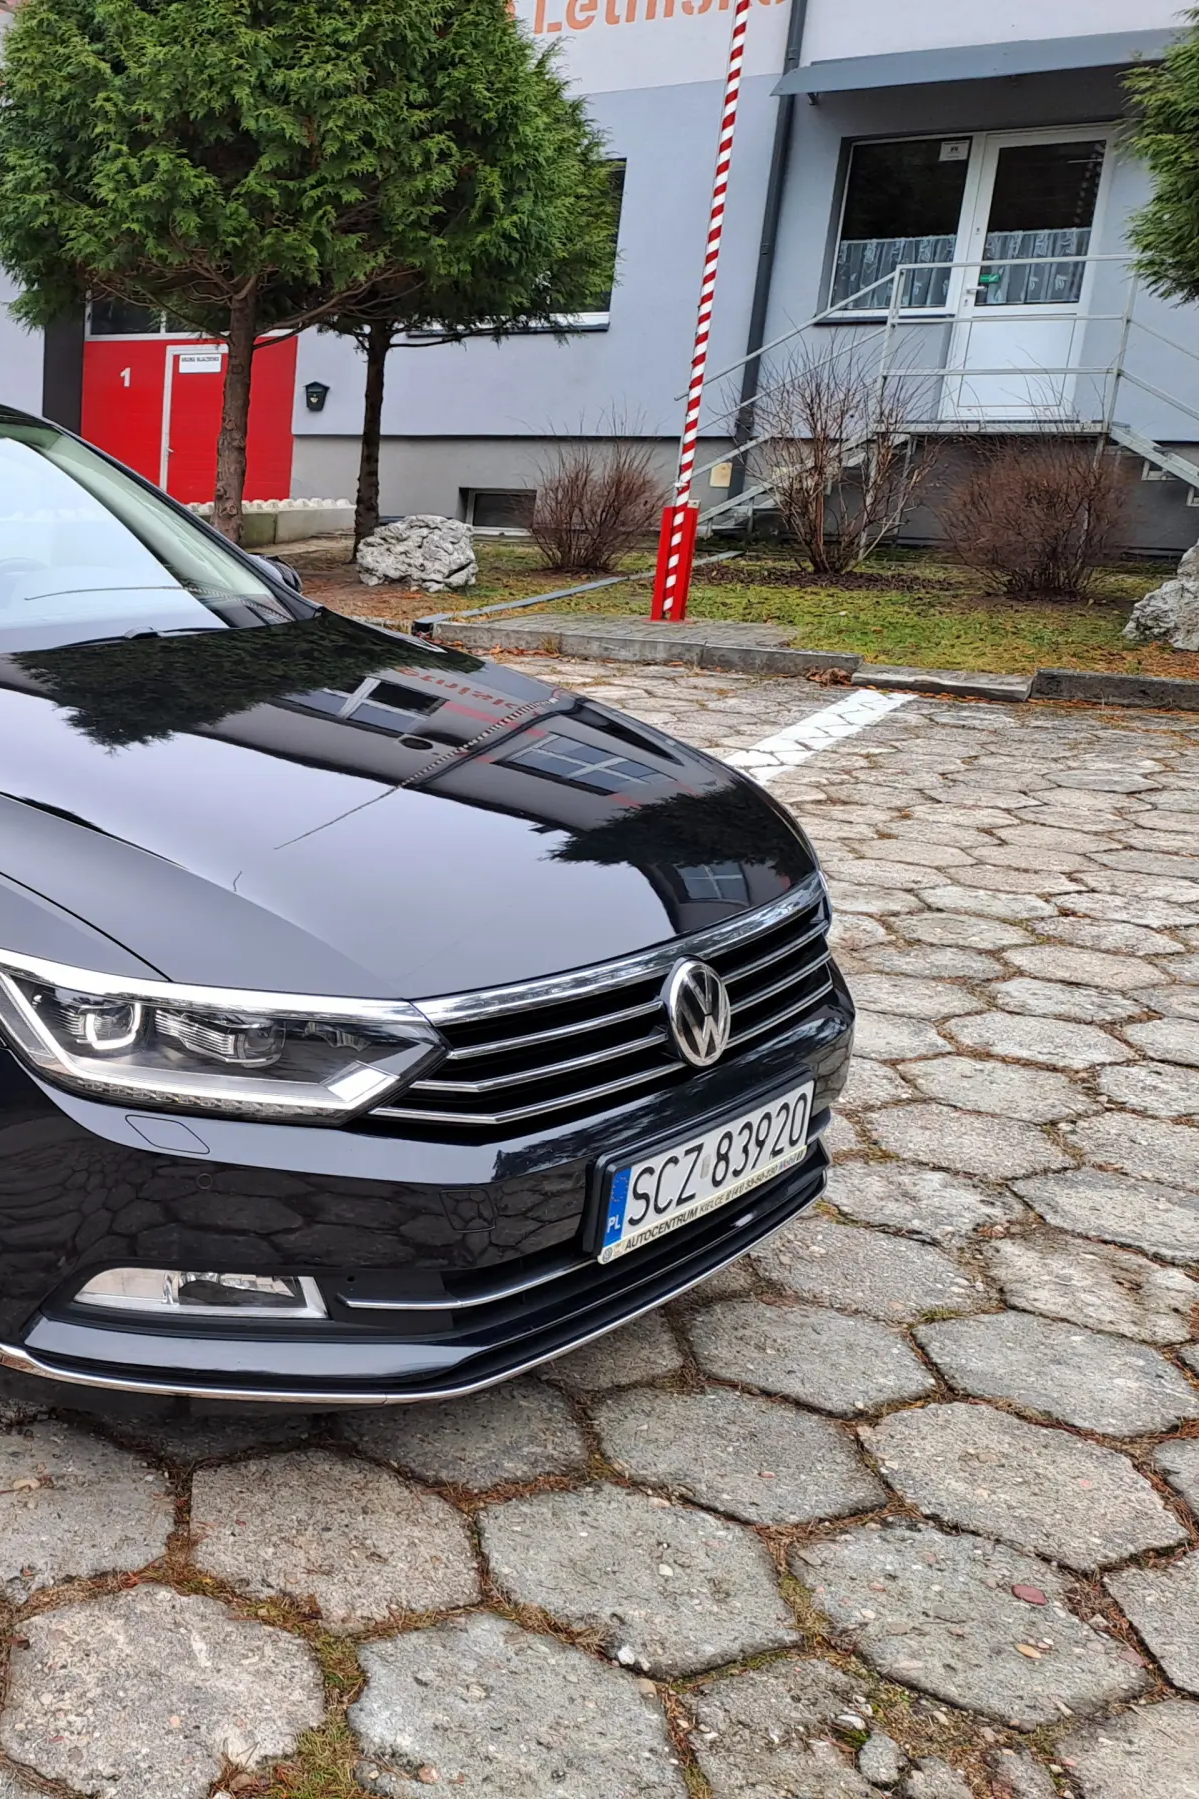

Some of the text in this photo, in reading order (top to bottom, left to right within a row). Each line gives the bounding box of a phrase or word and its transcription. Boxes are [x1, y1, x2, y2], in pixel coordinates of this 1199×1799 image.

[120, 367, 131, 387] 1
[628, 1092, 808, 1226] SCZ 83920
[607, 1214, 621, 1233] PL
[625, 1207, 698, 1250] AUTOCENTRUM
[700, 1193, 725, 1213] KIELCE
